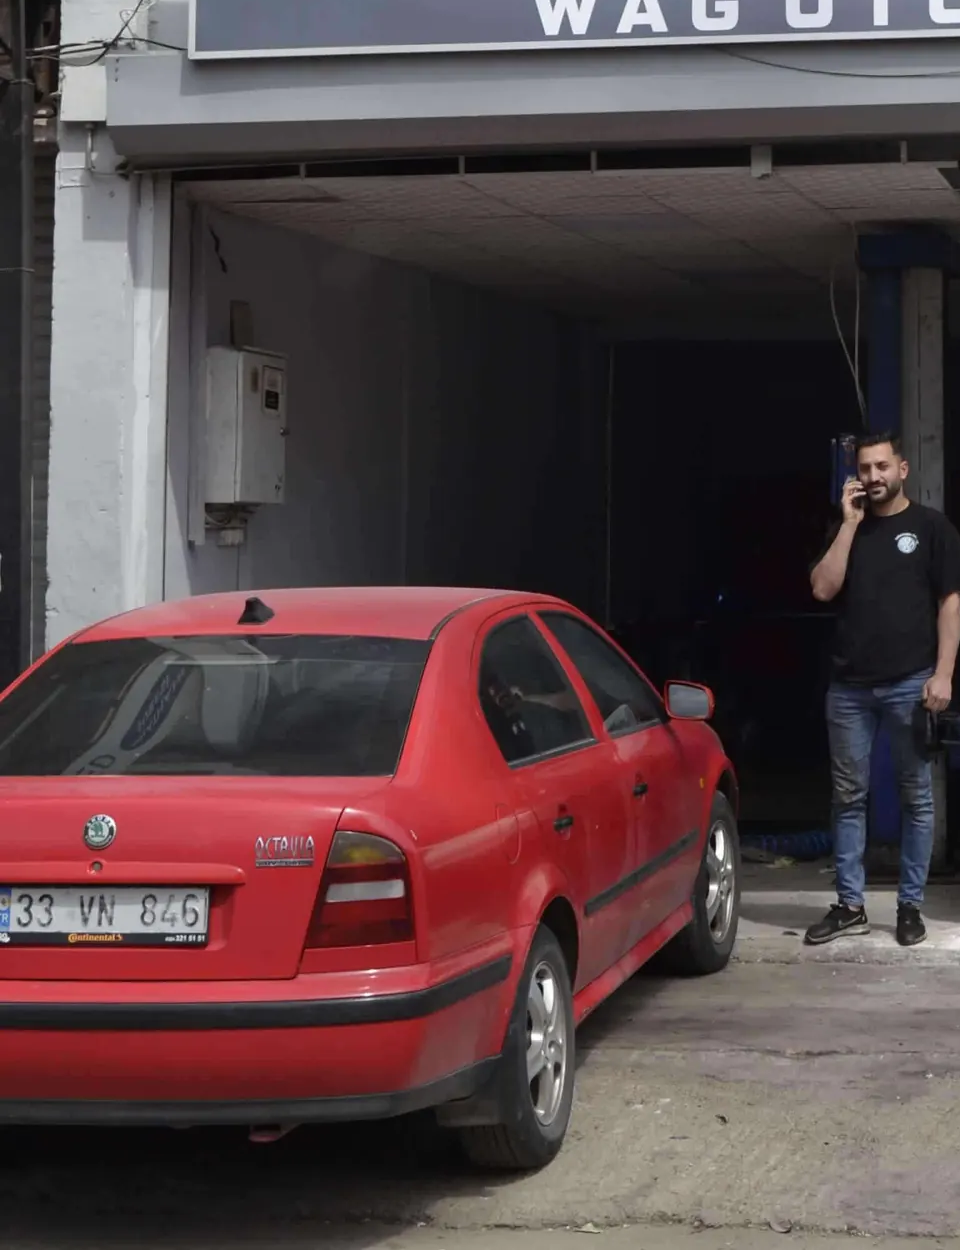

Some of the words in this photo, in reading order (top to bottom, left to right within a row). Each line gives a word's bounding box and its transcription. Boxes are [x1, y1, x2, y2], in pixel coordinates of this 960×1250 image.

[16, 894, 54, 928] 33
[79, 895, 116, 927] VN
[140, 894, 200, 928] 846
